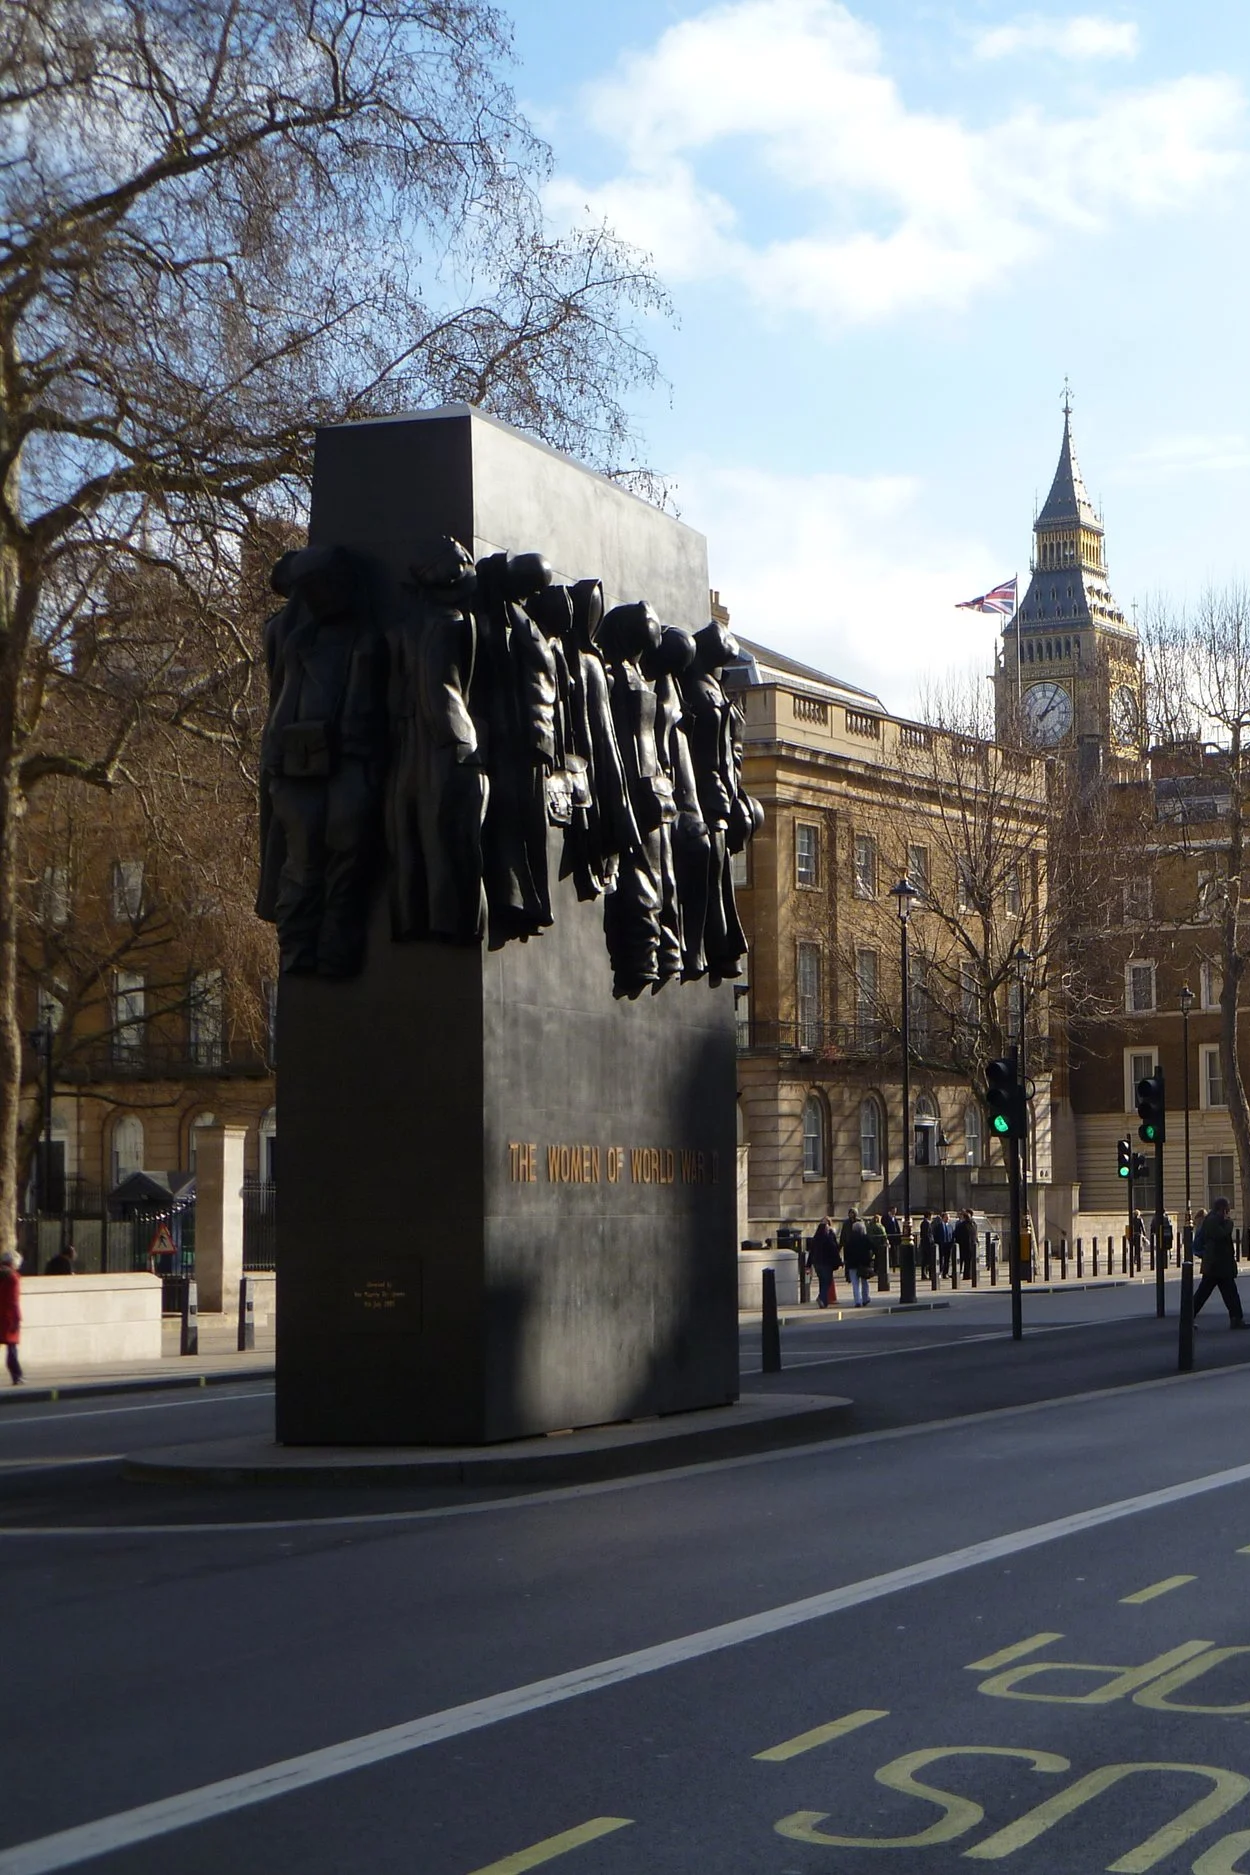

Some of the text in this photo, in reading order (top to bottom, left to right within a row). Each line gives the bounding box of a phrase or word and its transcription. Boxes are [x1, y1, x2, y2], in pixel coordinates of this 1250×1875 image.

[508, 1142, 537, 1183] THE
[546, 1144, 600, 1184] WOMEN
[606, 1146, 625, 1184] OF
[630, 1147, 674, 1184] WORLD
[680, 1149, 705, 1185] WAR
